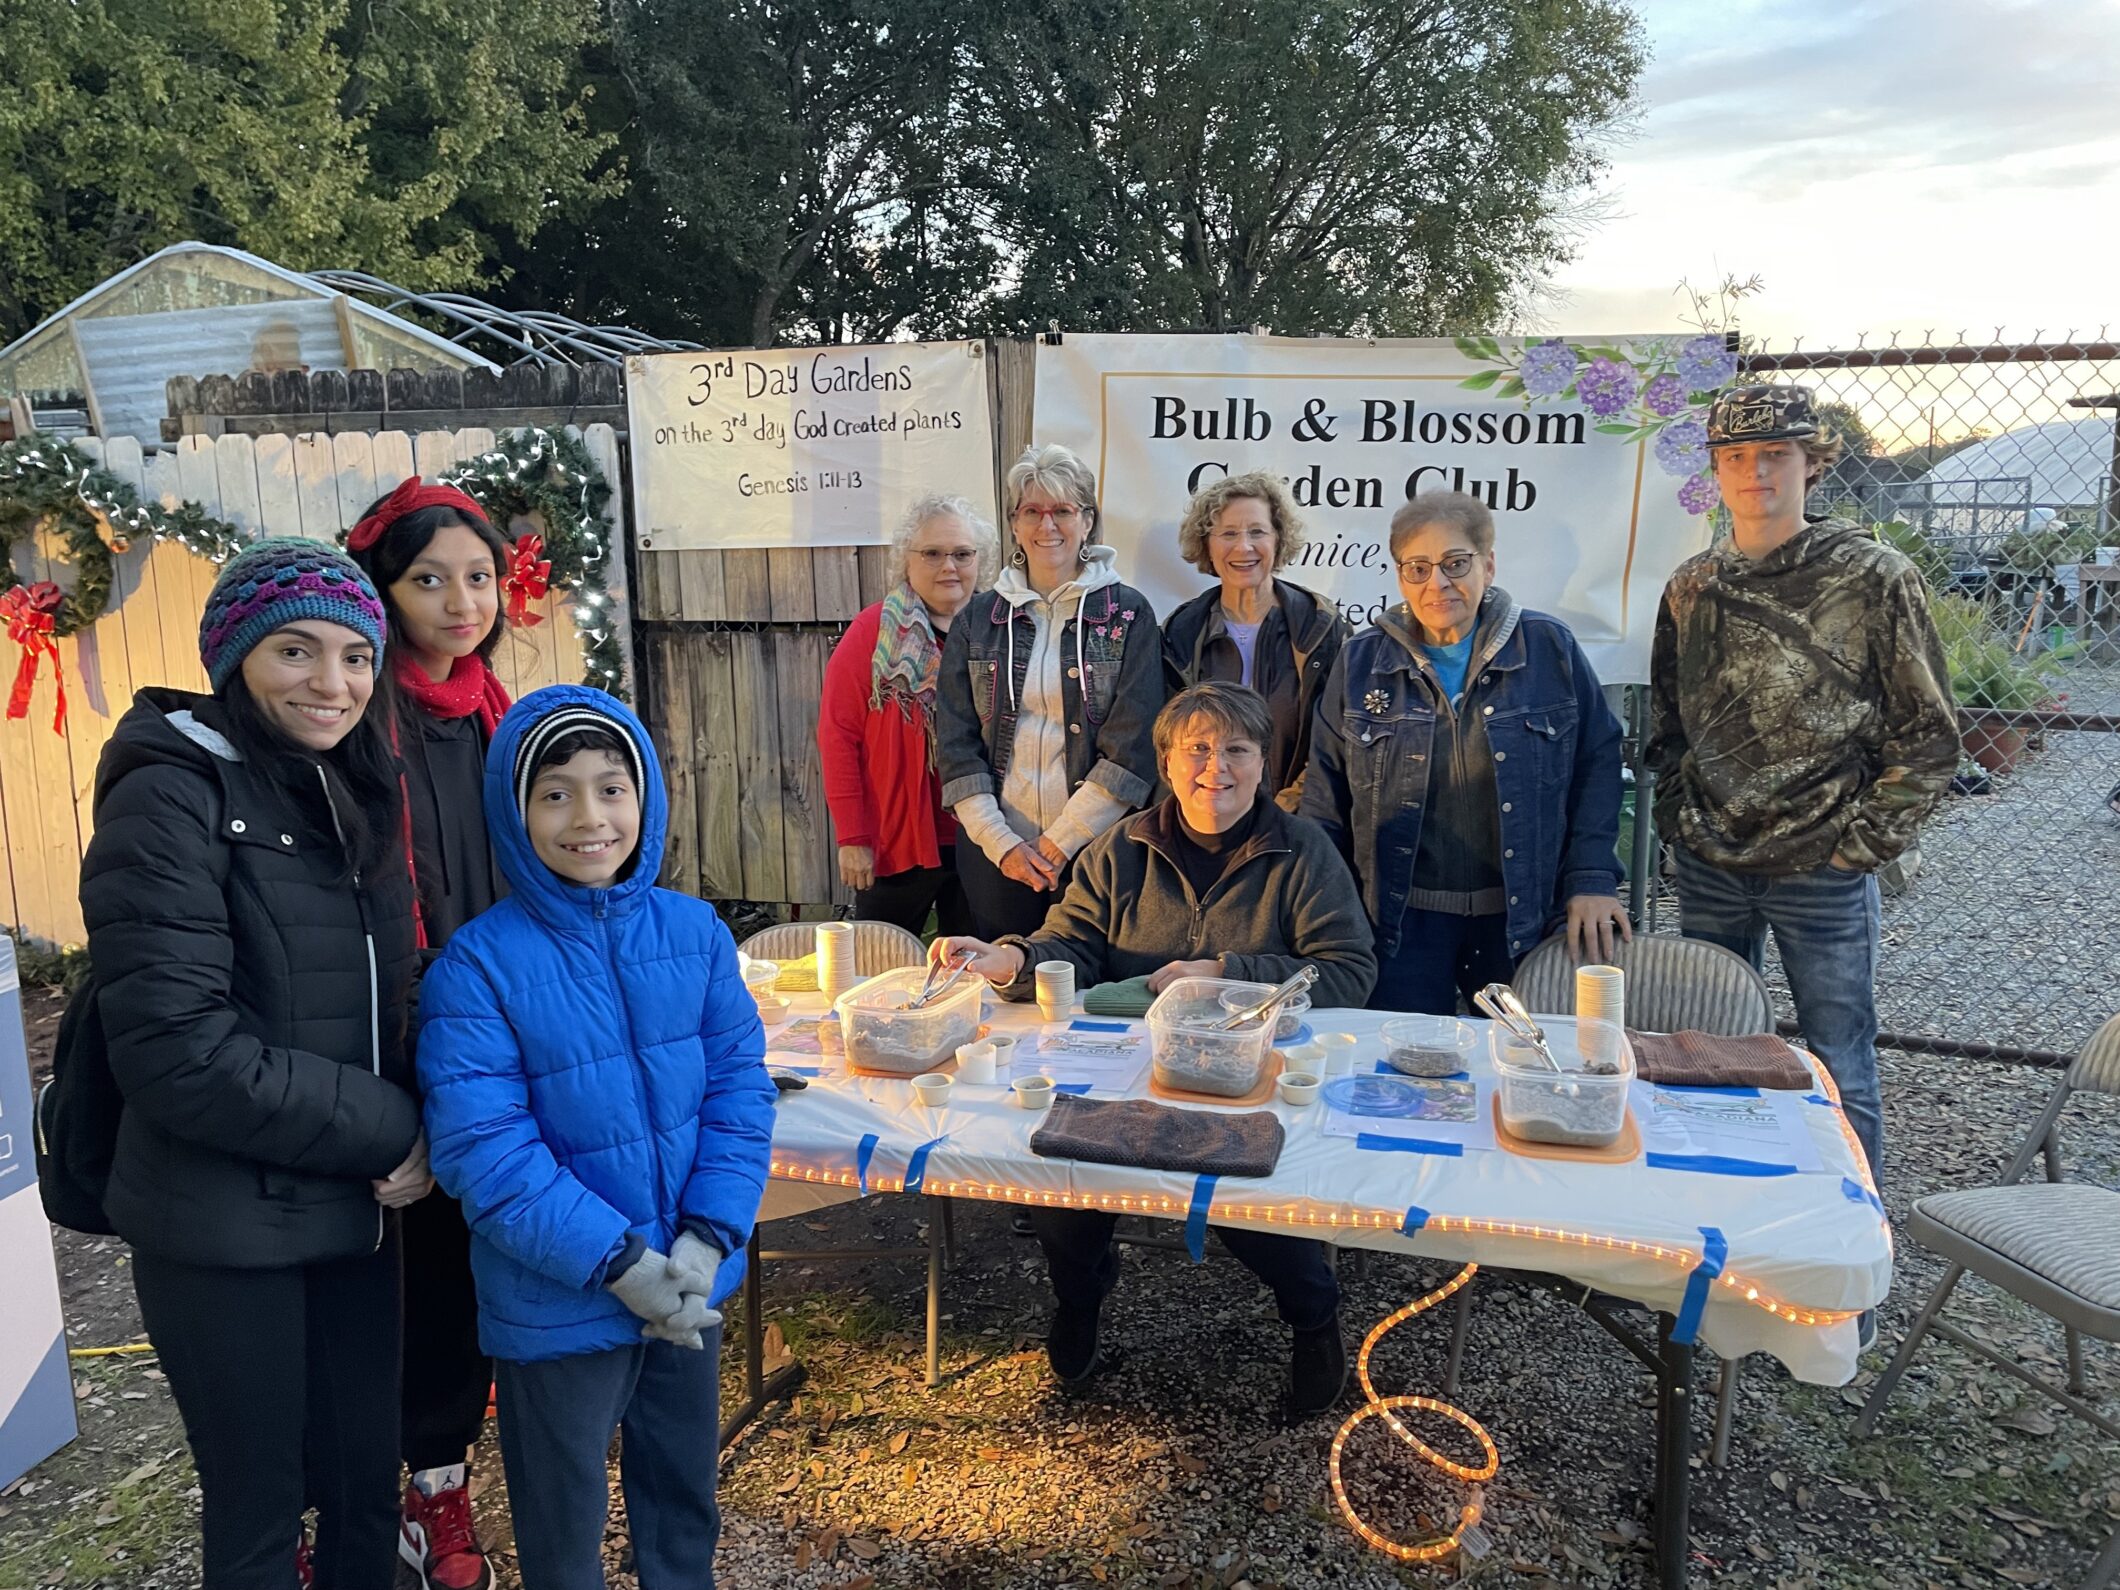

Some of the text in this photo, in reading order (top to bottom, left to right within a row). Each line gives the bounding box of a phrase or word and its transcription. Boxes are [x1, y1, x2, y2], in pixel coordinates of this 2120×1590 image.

[687, 352, 912, 406] 3rd Day Gardens
[655, 408, 963, 449] on the 3rd day God created plants
[1149, 396, 1586, 444] Bulb & Blossom
[738, 471, 809, 498] Genesis
[1187, 462, 1384, 508] Gden
[1288, 533, 1388, 576] nice,
[1335, 595, 1388, 626] ted
